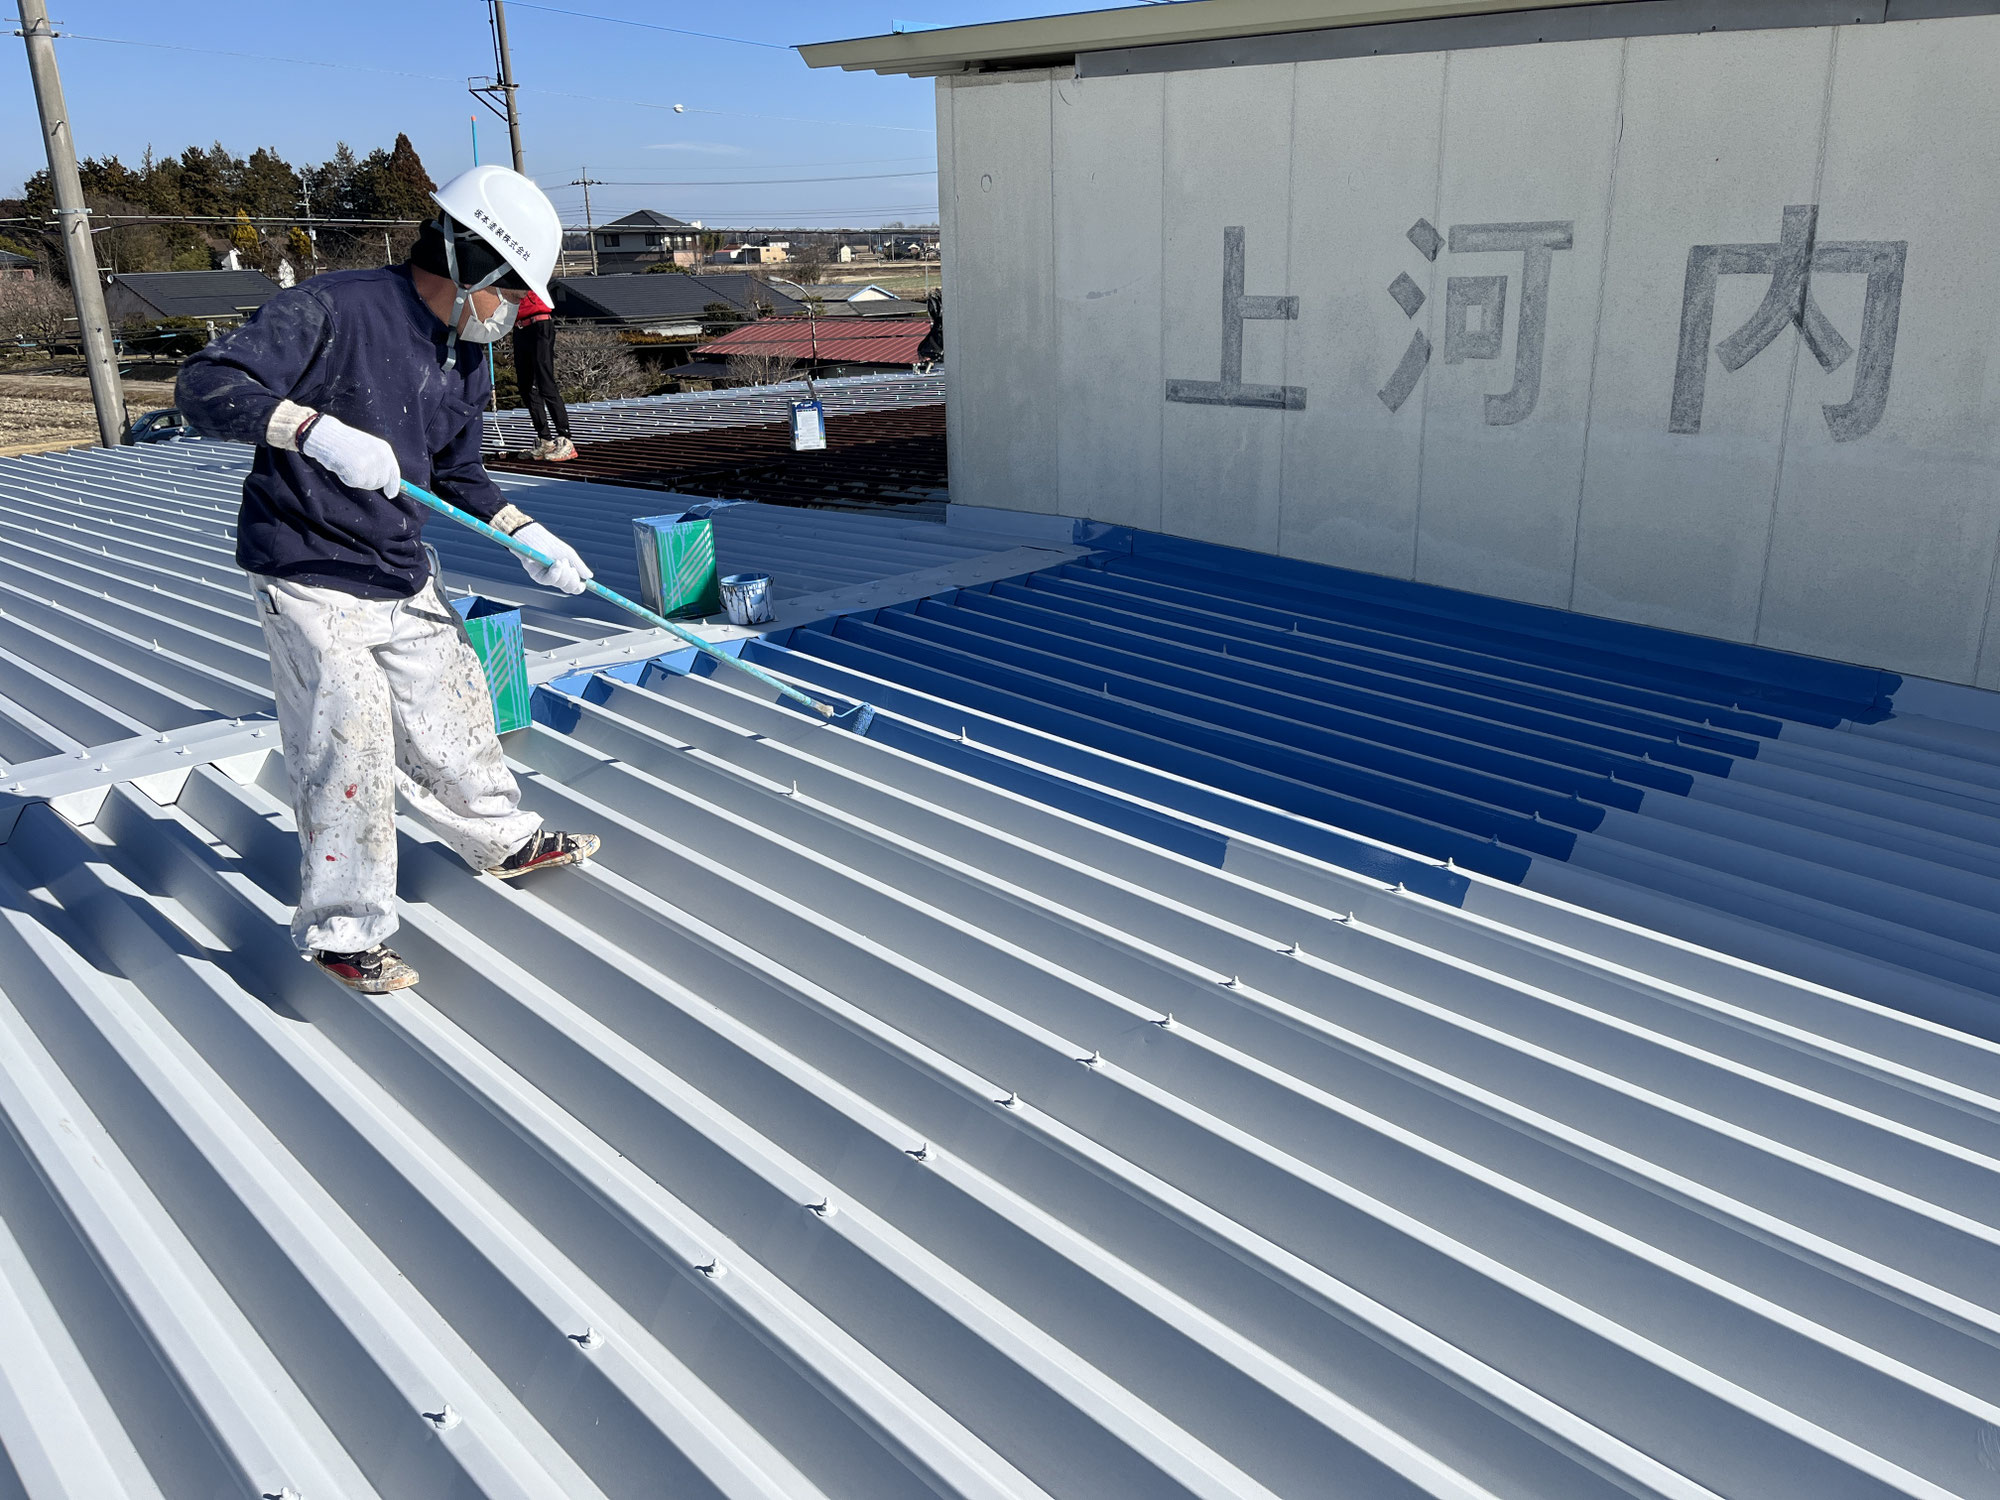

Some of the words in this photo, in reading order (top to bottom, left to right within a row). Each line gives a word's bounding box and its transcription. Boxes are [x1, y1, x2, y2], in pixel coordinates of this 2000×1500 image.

[474, 208, 531, 262] 坂本塗装株式会社
[1165, 204, 1908, 443] 上河内
